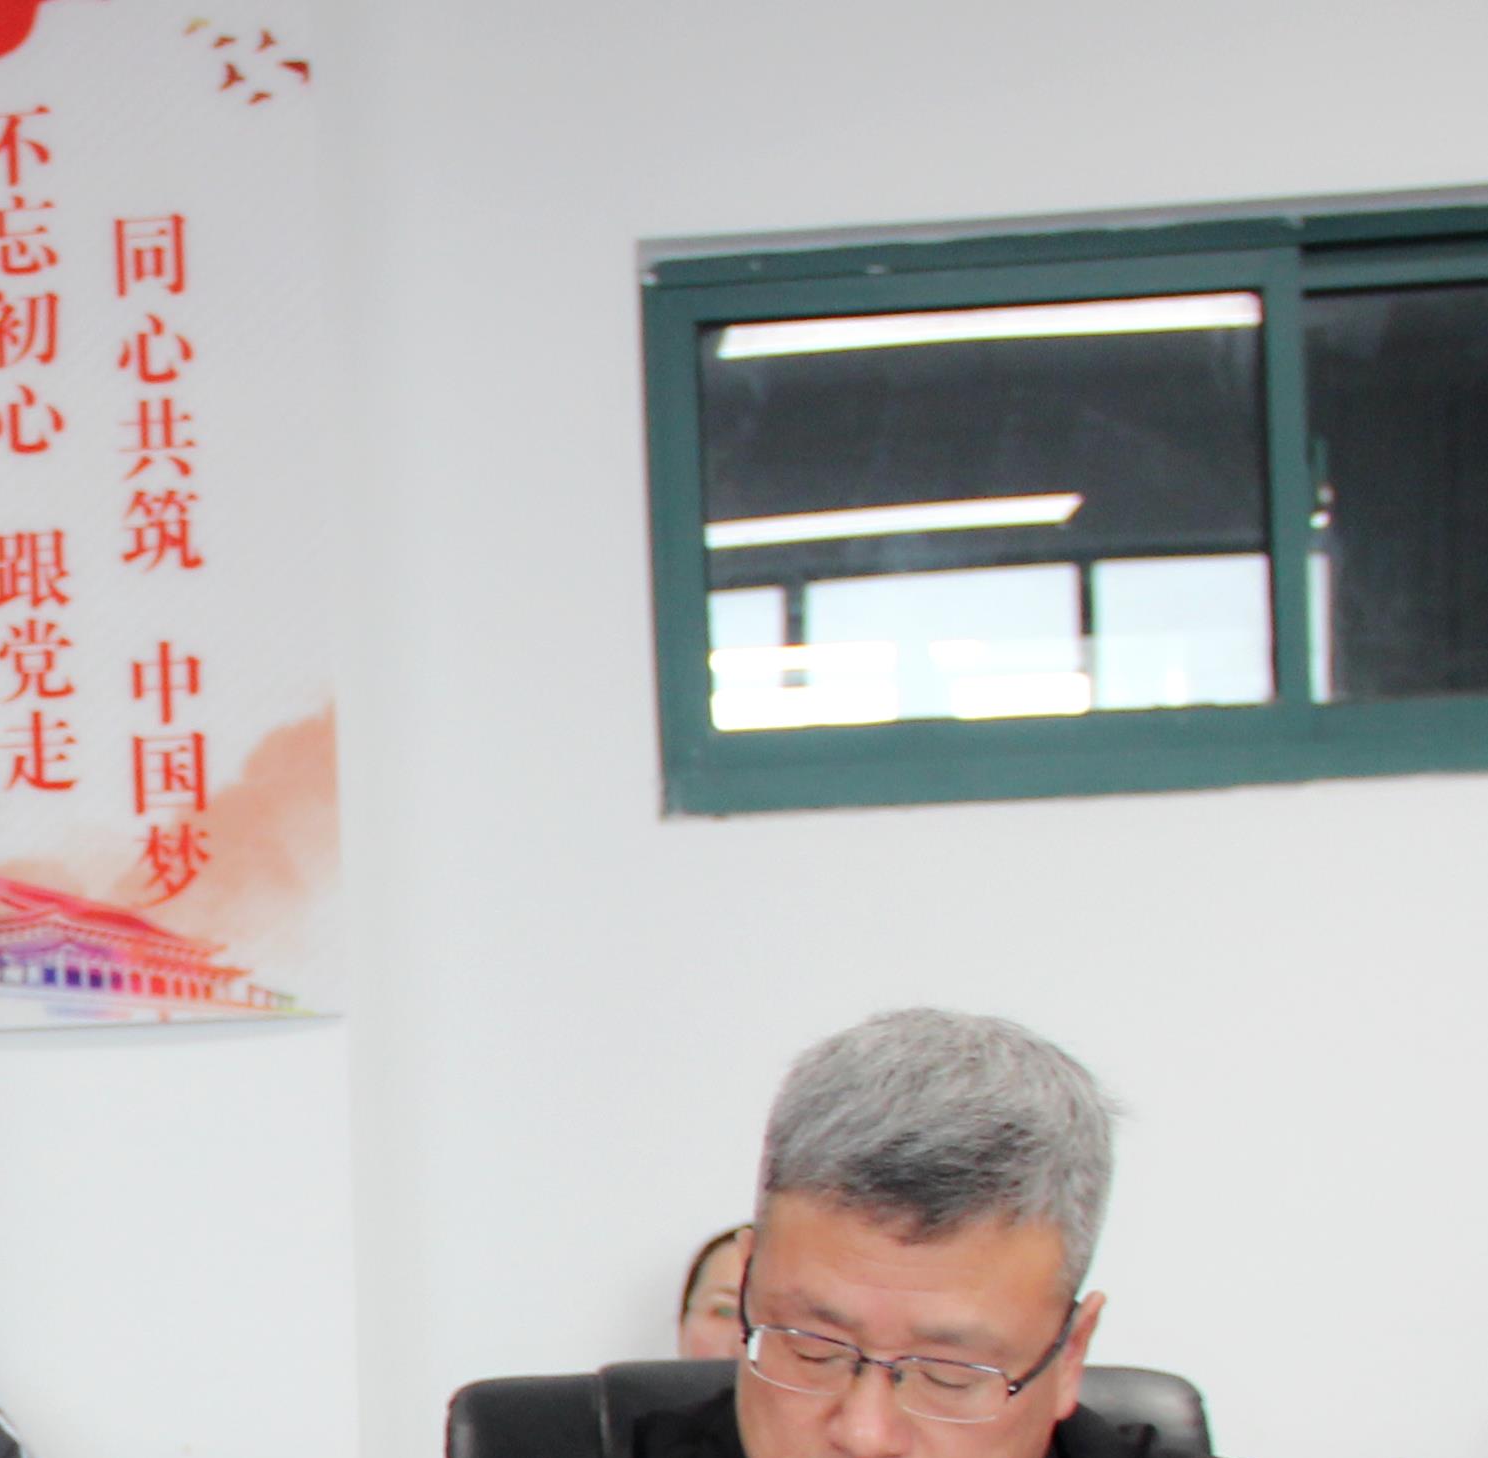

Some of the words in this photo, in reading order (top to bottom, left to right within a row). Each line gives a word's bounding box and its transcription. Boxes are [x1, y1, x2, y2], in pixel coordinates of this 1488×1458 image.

[111, 212, 205, 574] 同心共筑
[131, 640, 211, 909] 中国梦
